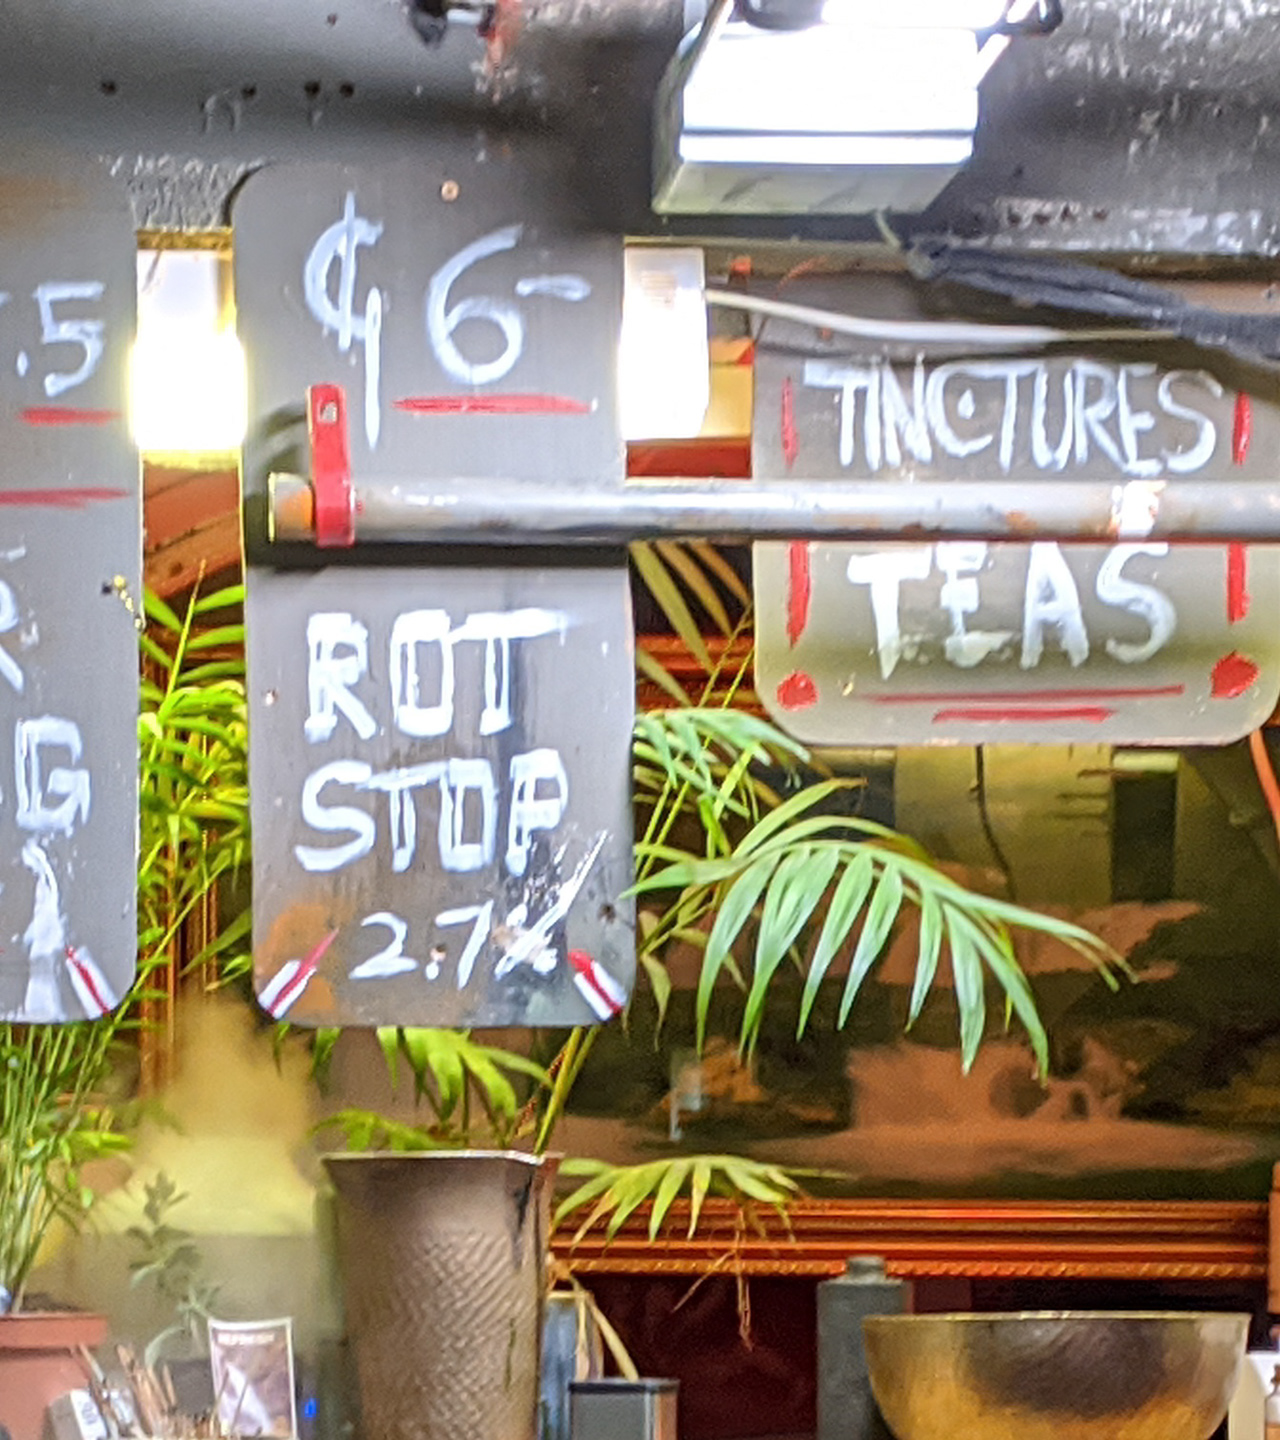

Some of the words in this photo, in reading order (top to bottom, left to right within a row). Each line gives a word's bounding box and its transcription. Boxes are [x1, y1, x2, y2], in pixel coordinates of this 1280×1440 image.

[804, 351, 1224, 477] TINCTURES
[305, 609, 580, 740] ROT
[846, 541, 1178, 679] TEAS
[295, 748, 569, 875] STOP
